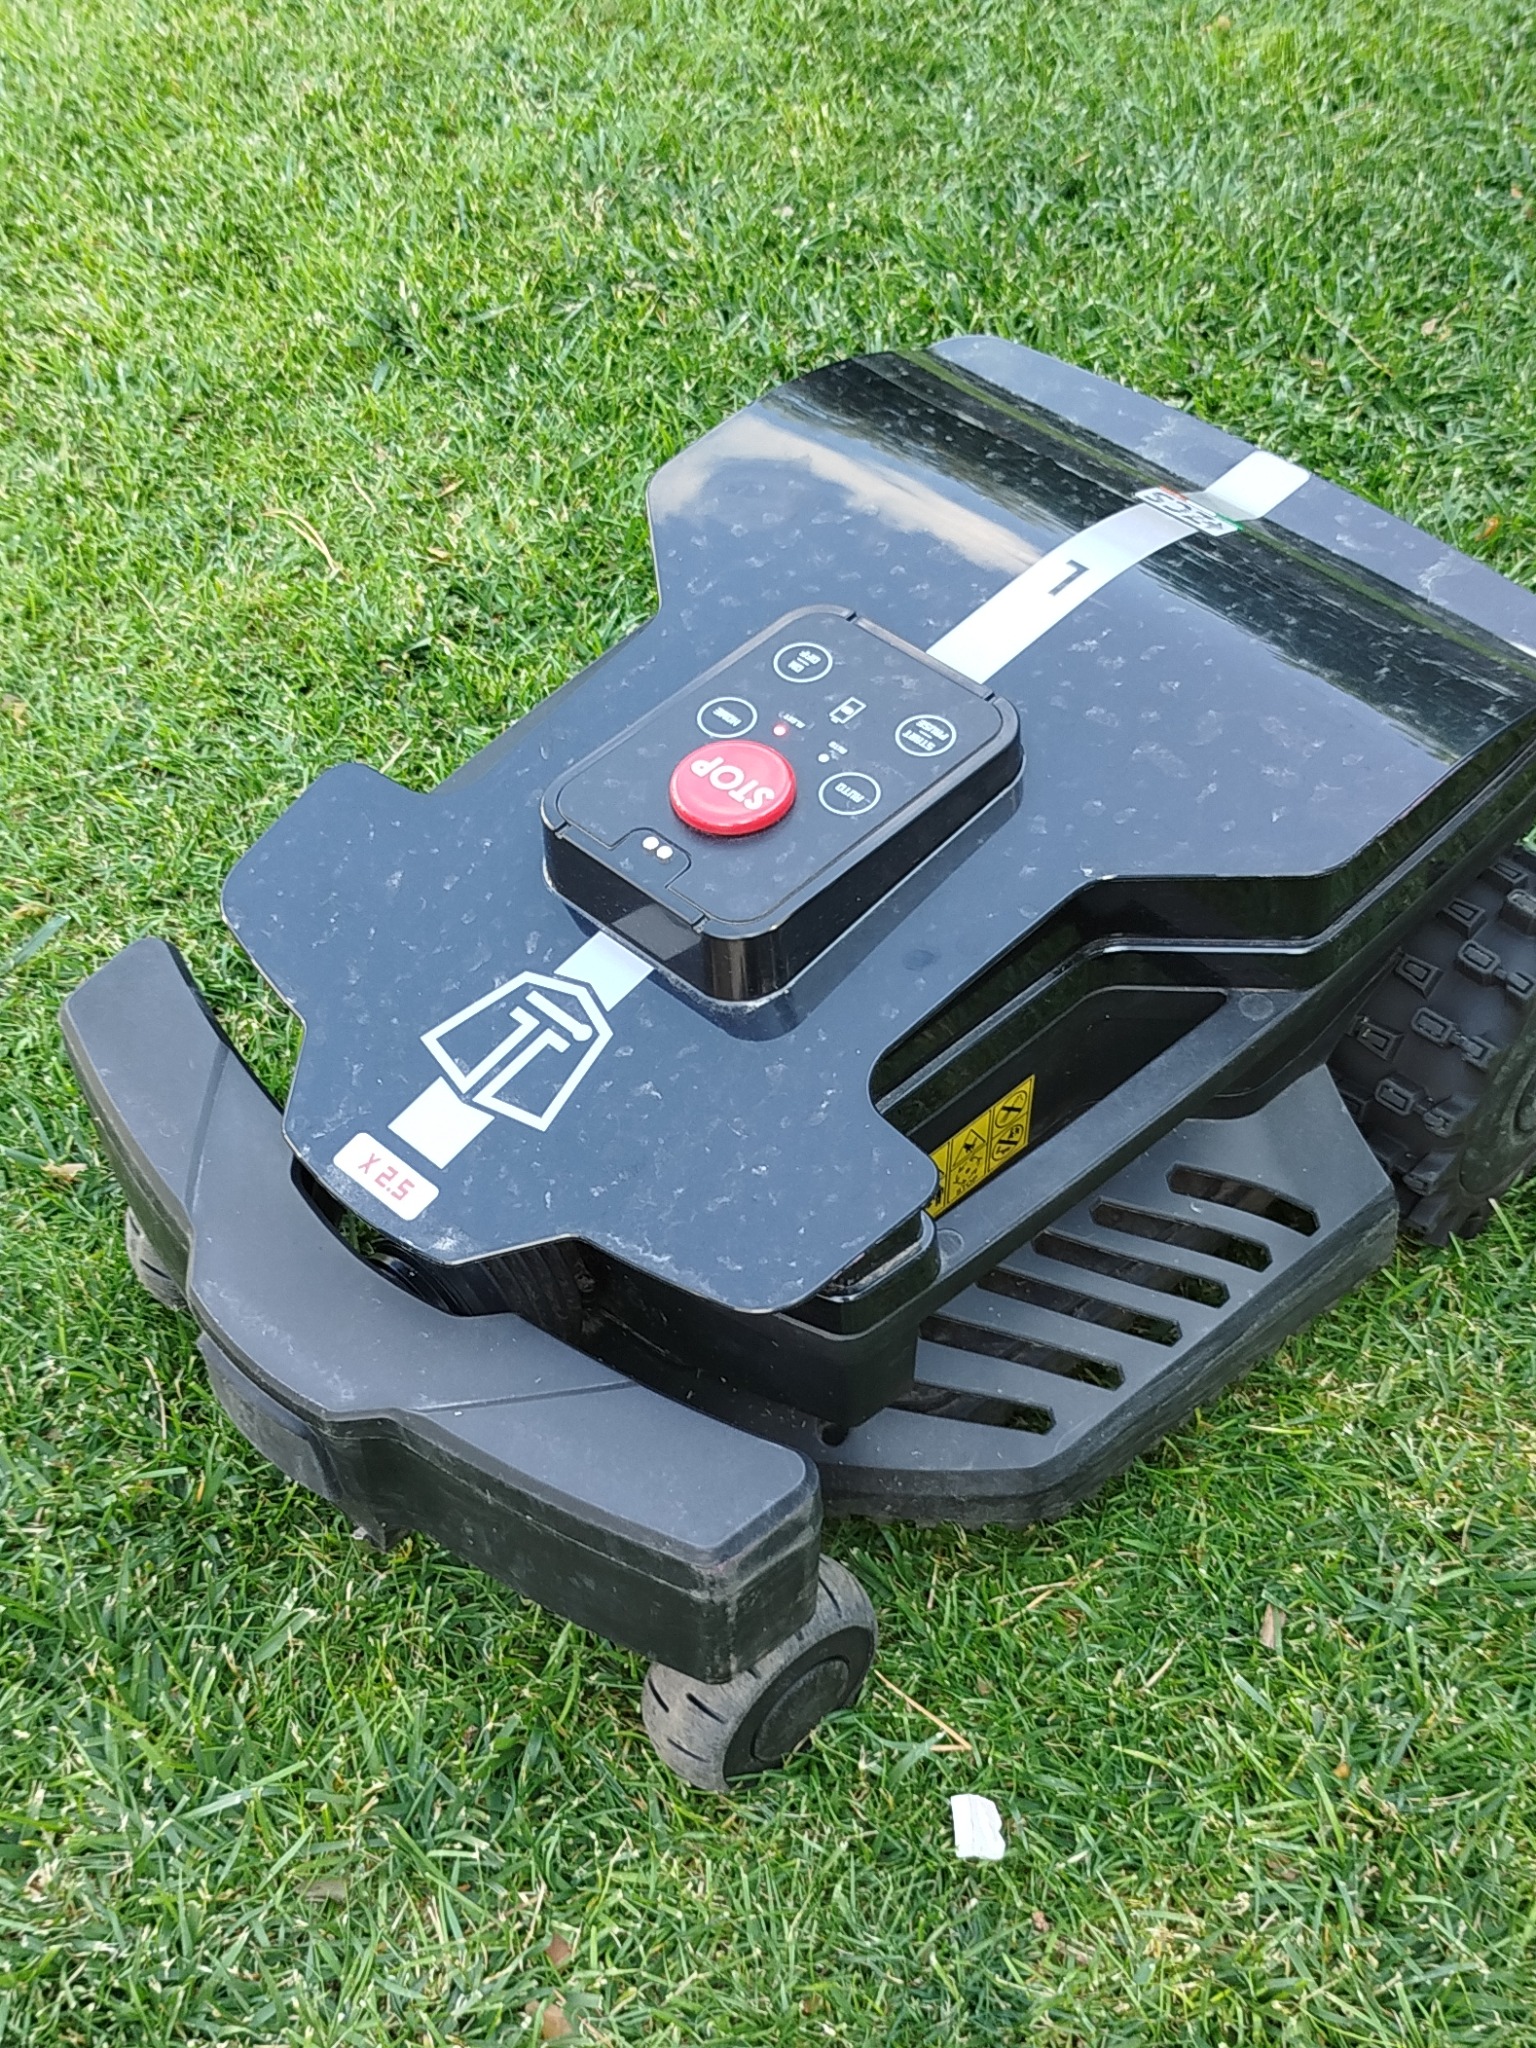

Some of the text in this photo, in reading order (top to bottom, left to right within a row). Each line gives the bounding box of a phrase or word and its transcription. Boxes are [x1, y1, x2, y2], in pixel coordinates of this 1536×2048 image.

[799, 650, 821, 665] OFF
[901, 730, 936, 752] START
[915, 719, 950, 741] PAUSE
[690, 756, 775, 811] STOP
[834, 782, 865, 803] AUTO
[357, 1152, 415, 1201] X 2.5
